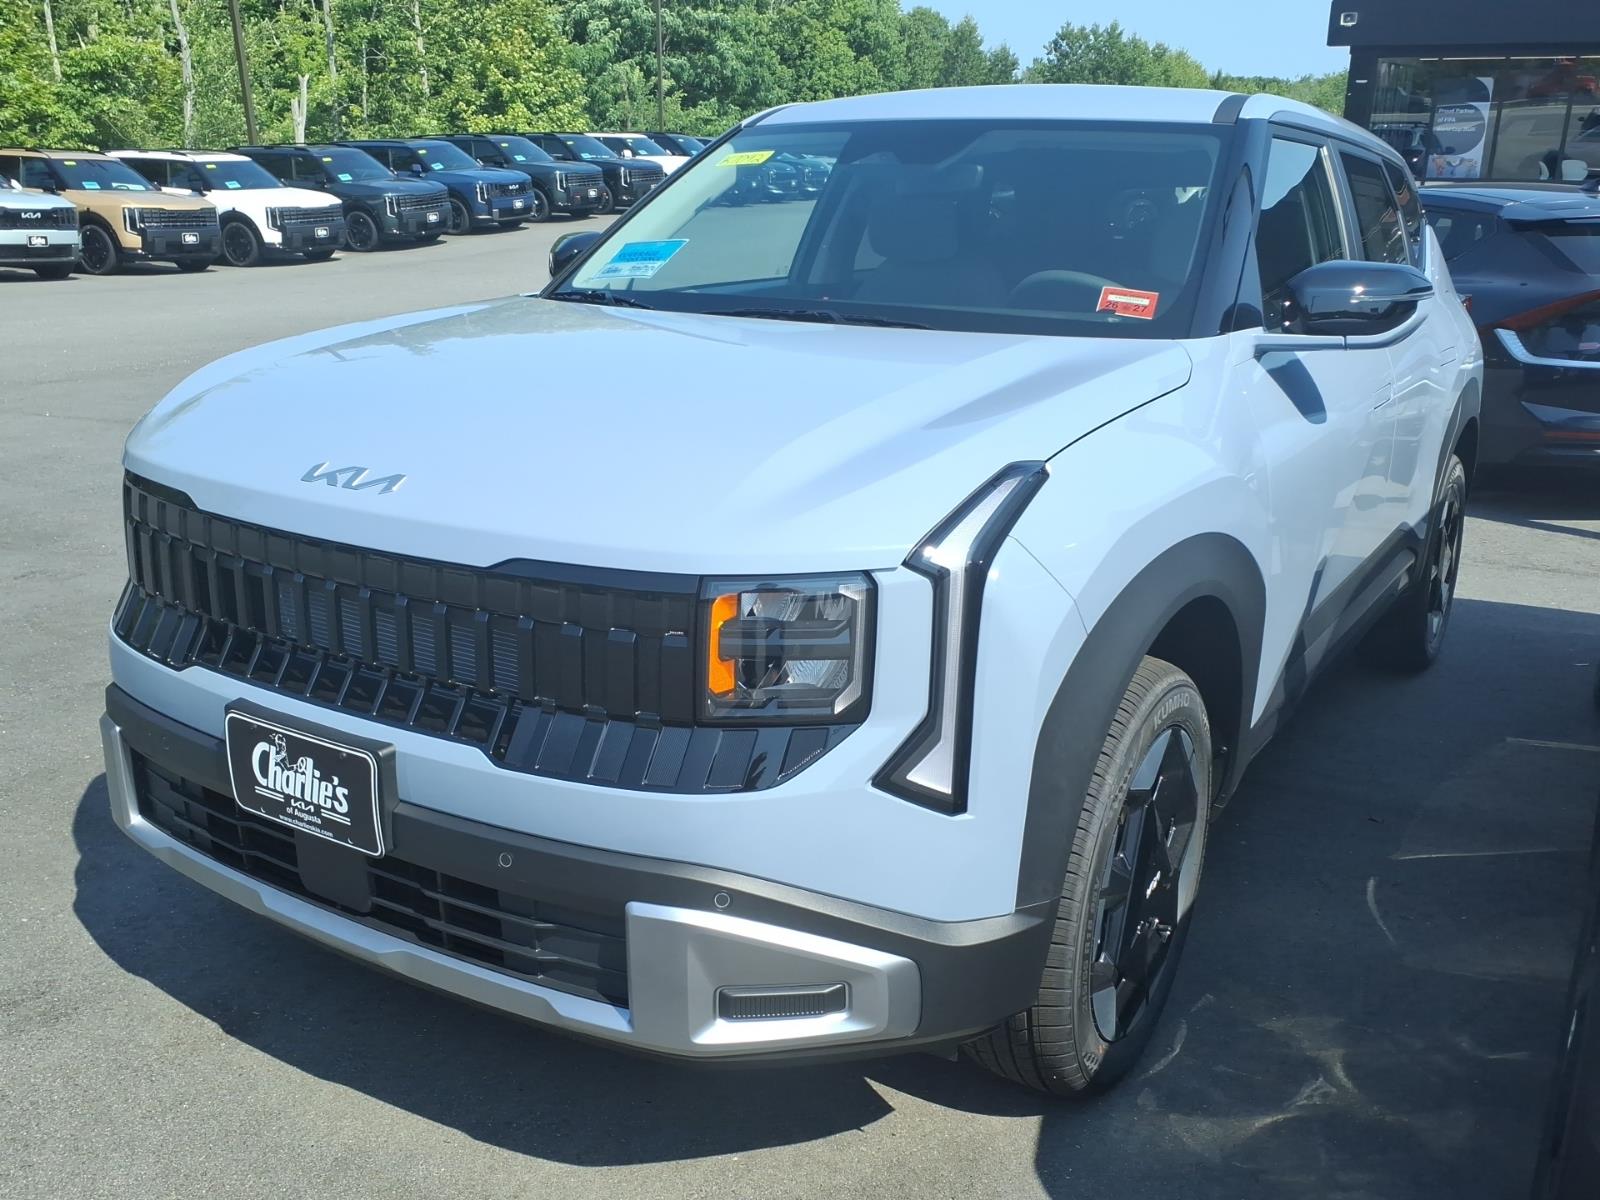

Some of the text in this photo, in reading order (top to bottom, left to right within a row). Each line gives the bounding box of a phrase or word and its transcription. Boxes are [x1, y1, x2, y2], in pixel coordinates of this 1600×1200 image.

[301, 461, 406, 495] KIA
[1153, 692, 1190, 731] KUMHO
[252, 741, 349, 814] Charlie's
[291, 798, 315, 813] KIA
[294, 808, 322, 825] Augusta
